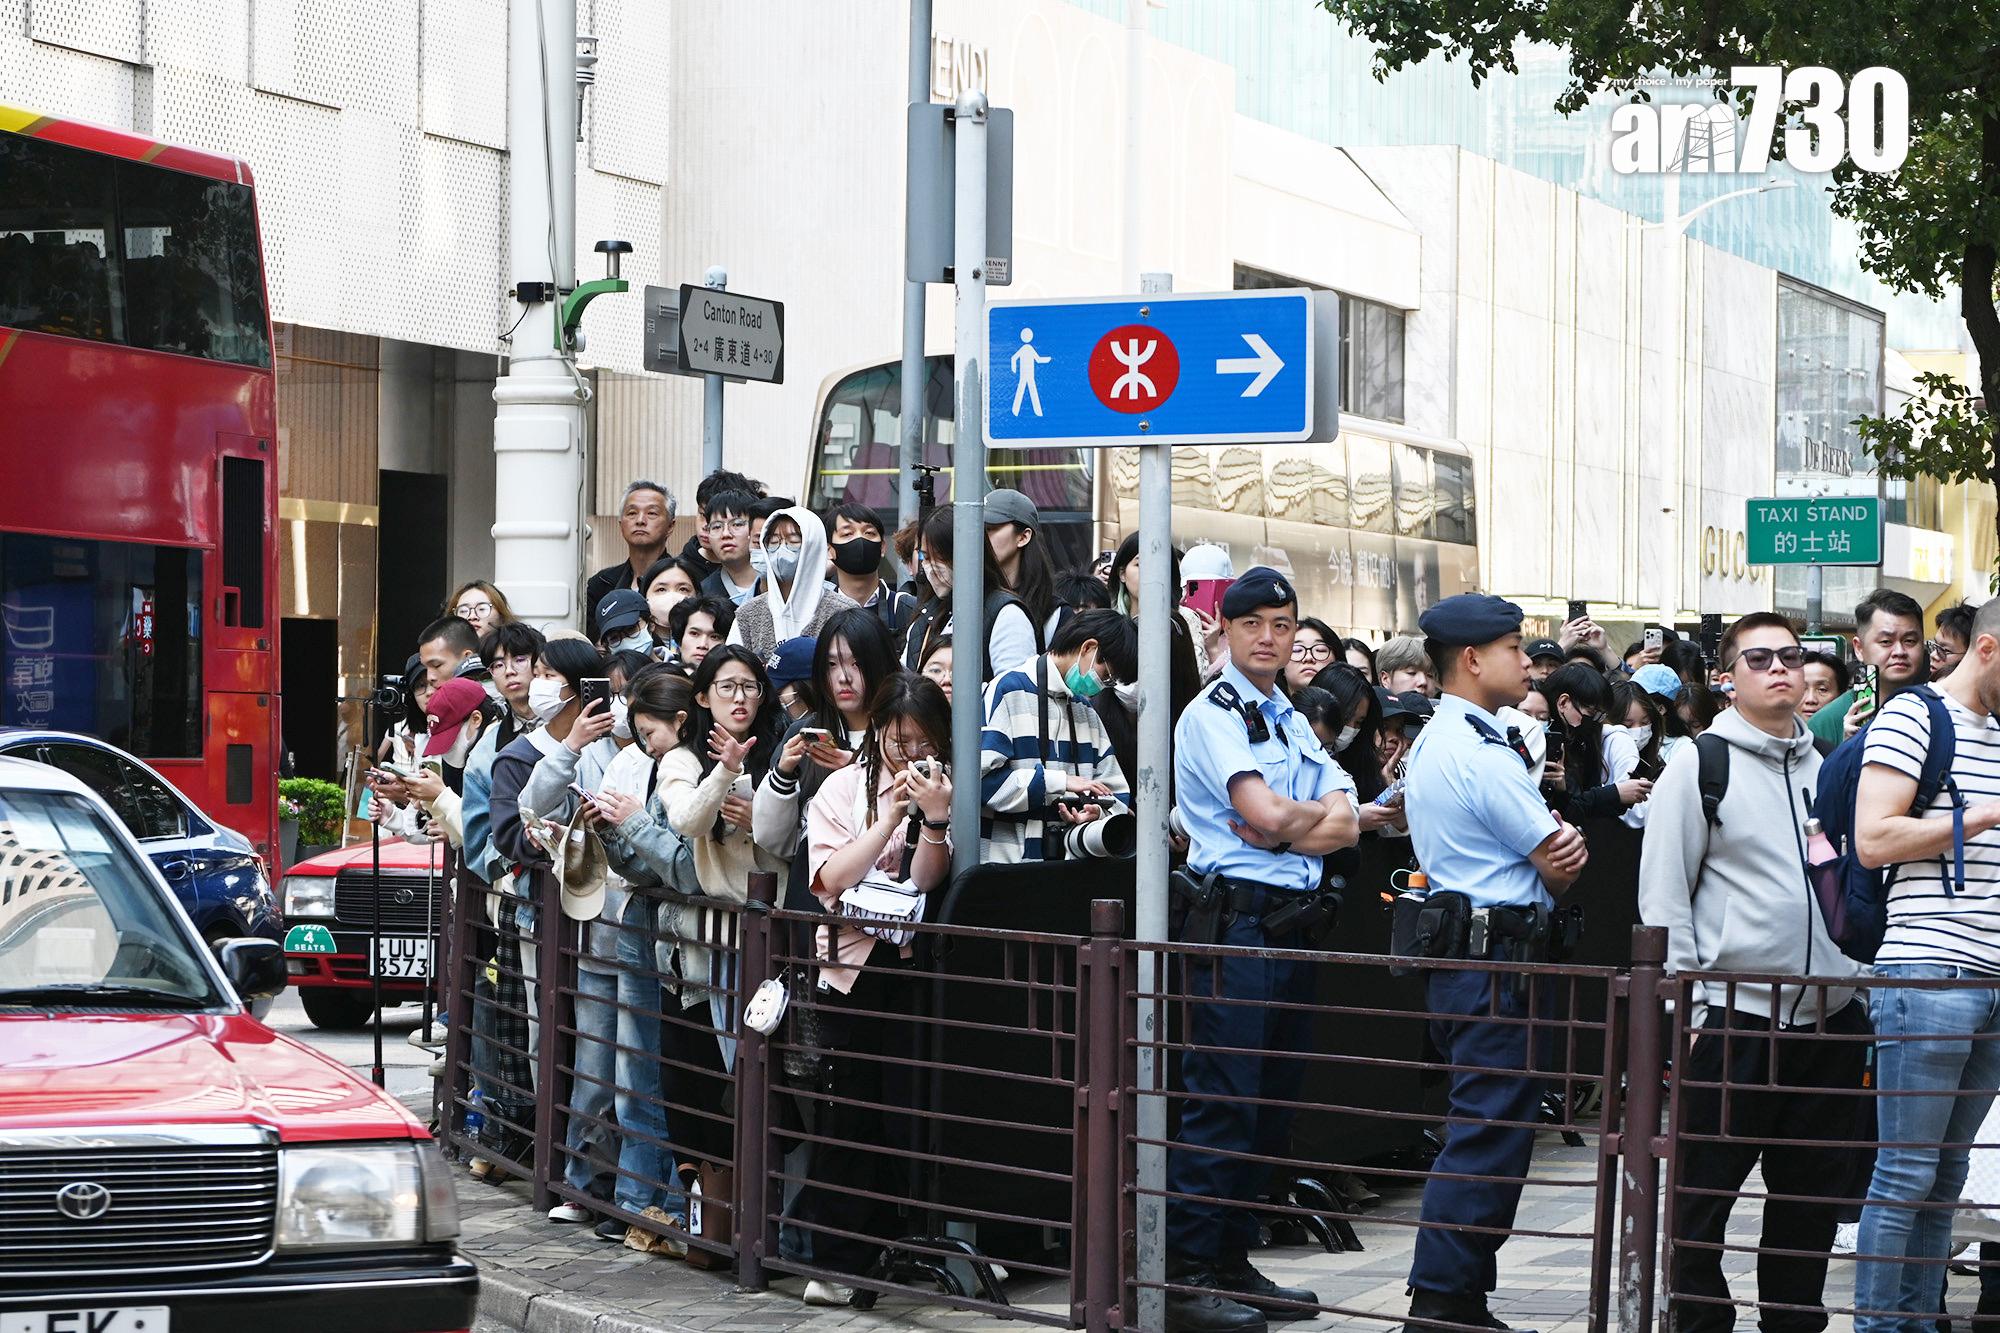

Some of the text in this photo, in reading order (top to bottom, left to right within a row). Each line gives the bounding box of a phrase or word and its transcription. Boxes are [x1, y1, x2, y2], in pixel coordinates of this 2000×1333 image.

[703, 300, 762, 329] Canton Road
[713, 336, 751, 367] 廣東道
[1821, 441, 1854, 478] BEERS
[1758, 506, 1868, 522] TAXI STAND
[1774, 530, 1851, 553] 的士站
[1703, 525, 1766, 584] GUC
[303, 931, 314, 943] 4
[294, 944, 326, 952] SEATS
[389, 939, 416, 958] UU
[380, 957, 429, 977] 3573
